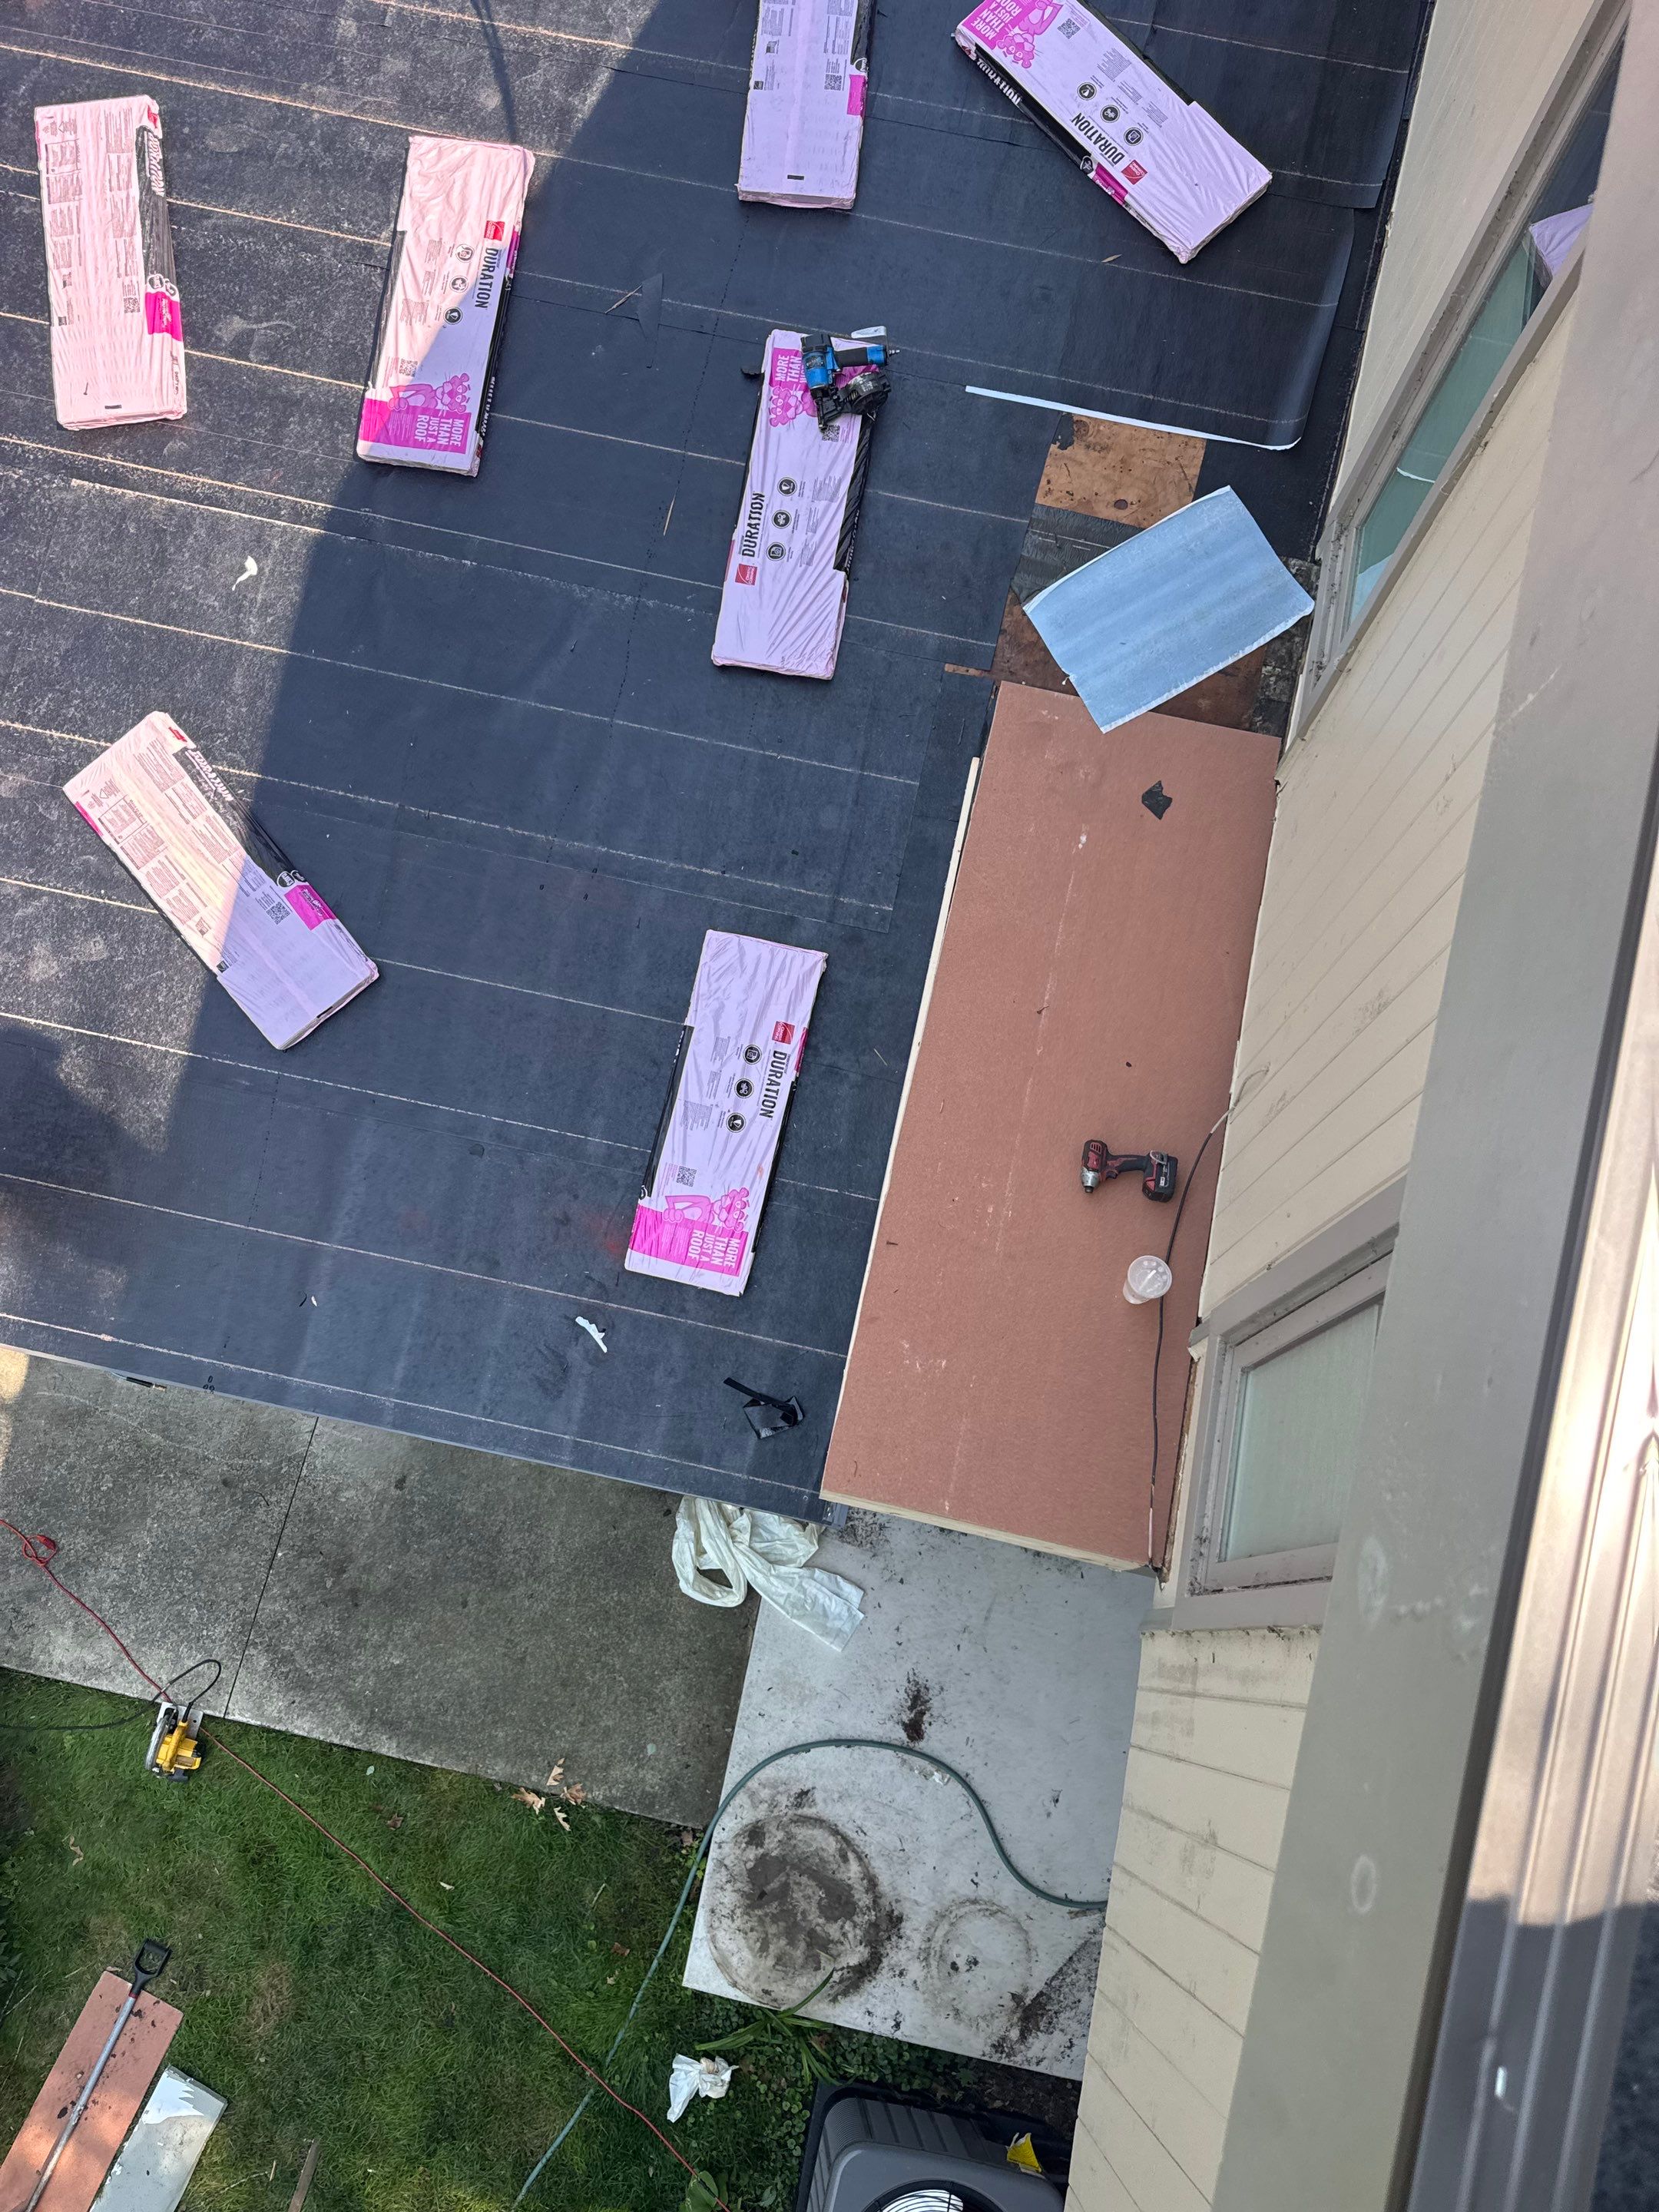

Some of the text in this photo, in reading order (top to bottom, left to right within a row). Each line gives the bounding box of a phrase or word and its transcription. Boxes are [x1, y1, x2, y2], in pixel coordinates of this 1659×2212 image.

[979, 8, 1005, 33] THAN
[994, 6, 1013, 24] JUST
[999, 0, 1022, 16] ROO
[971, 17, 997, 40] MORE
[1071, 112, 1125, 165] DURATION
[475, 247, 498, 309] DURATION
[775, 354, 790, 382] MORE
[786, 356, 802, 382] THAN
[415, 415, 429, 442] ROOF
[428, 416, 439, 435] JUST
[437, 418, 453, 445] THAN
[450, 419, 464, 446] MORE
[742, 492, 765, 557] DURATION
[760, 1050, 787, 1118] DURATION
[688, 1229, 704, 1262] ROOF
[702, 1233, 715, 1254] JUST
[710, 1237, 728, 1266] THAN
[724, 1237, 740, 1268] MORE
